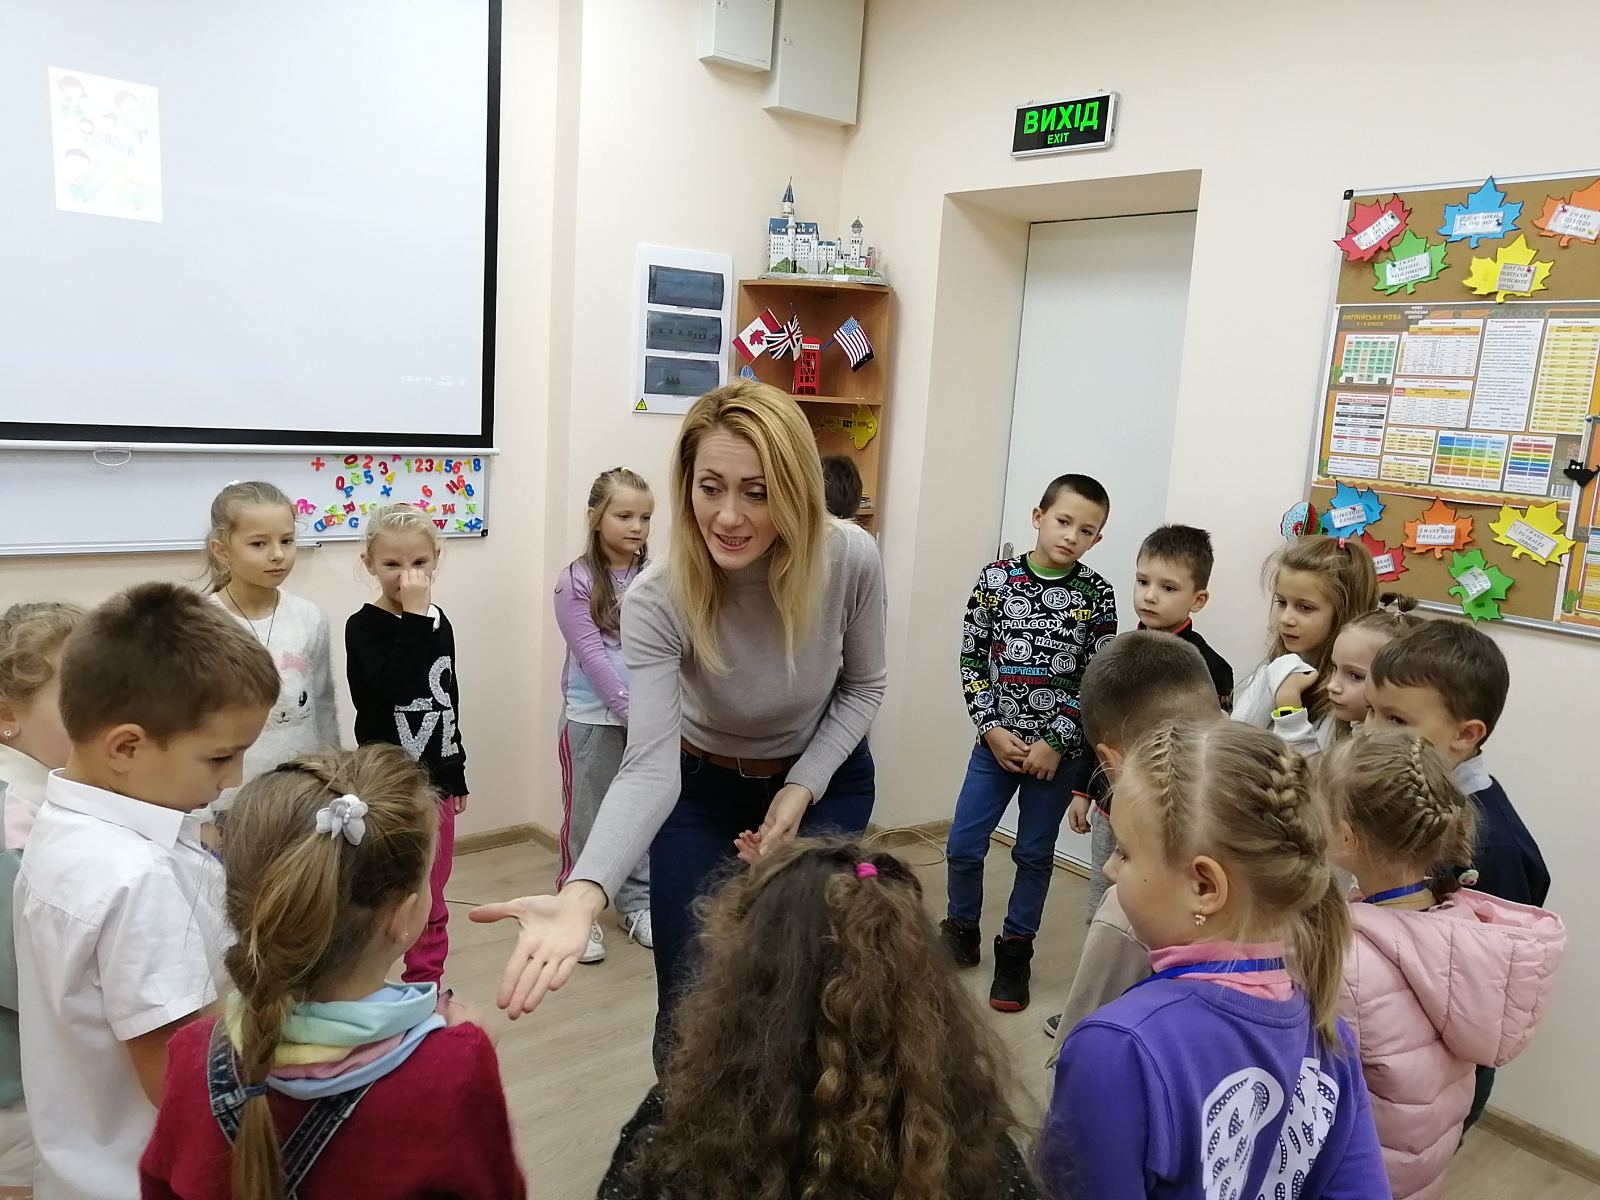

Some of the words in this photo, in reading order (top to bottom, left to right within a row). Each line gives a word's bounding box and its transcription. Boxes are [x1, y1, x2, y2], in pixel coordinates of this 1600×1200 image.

[1024, 101, 1099, 134] ВИХІД
[1047, 132, 1070, 145] EXIT
[1001, 619, 1062, 630] FALCON
[999, 665, 1048, 676] CAPTAIN
